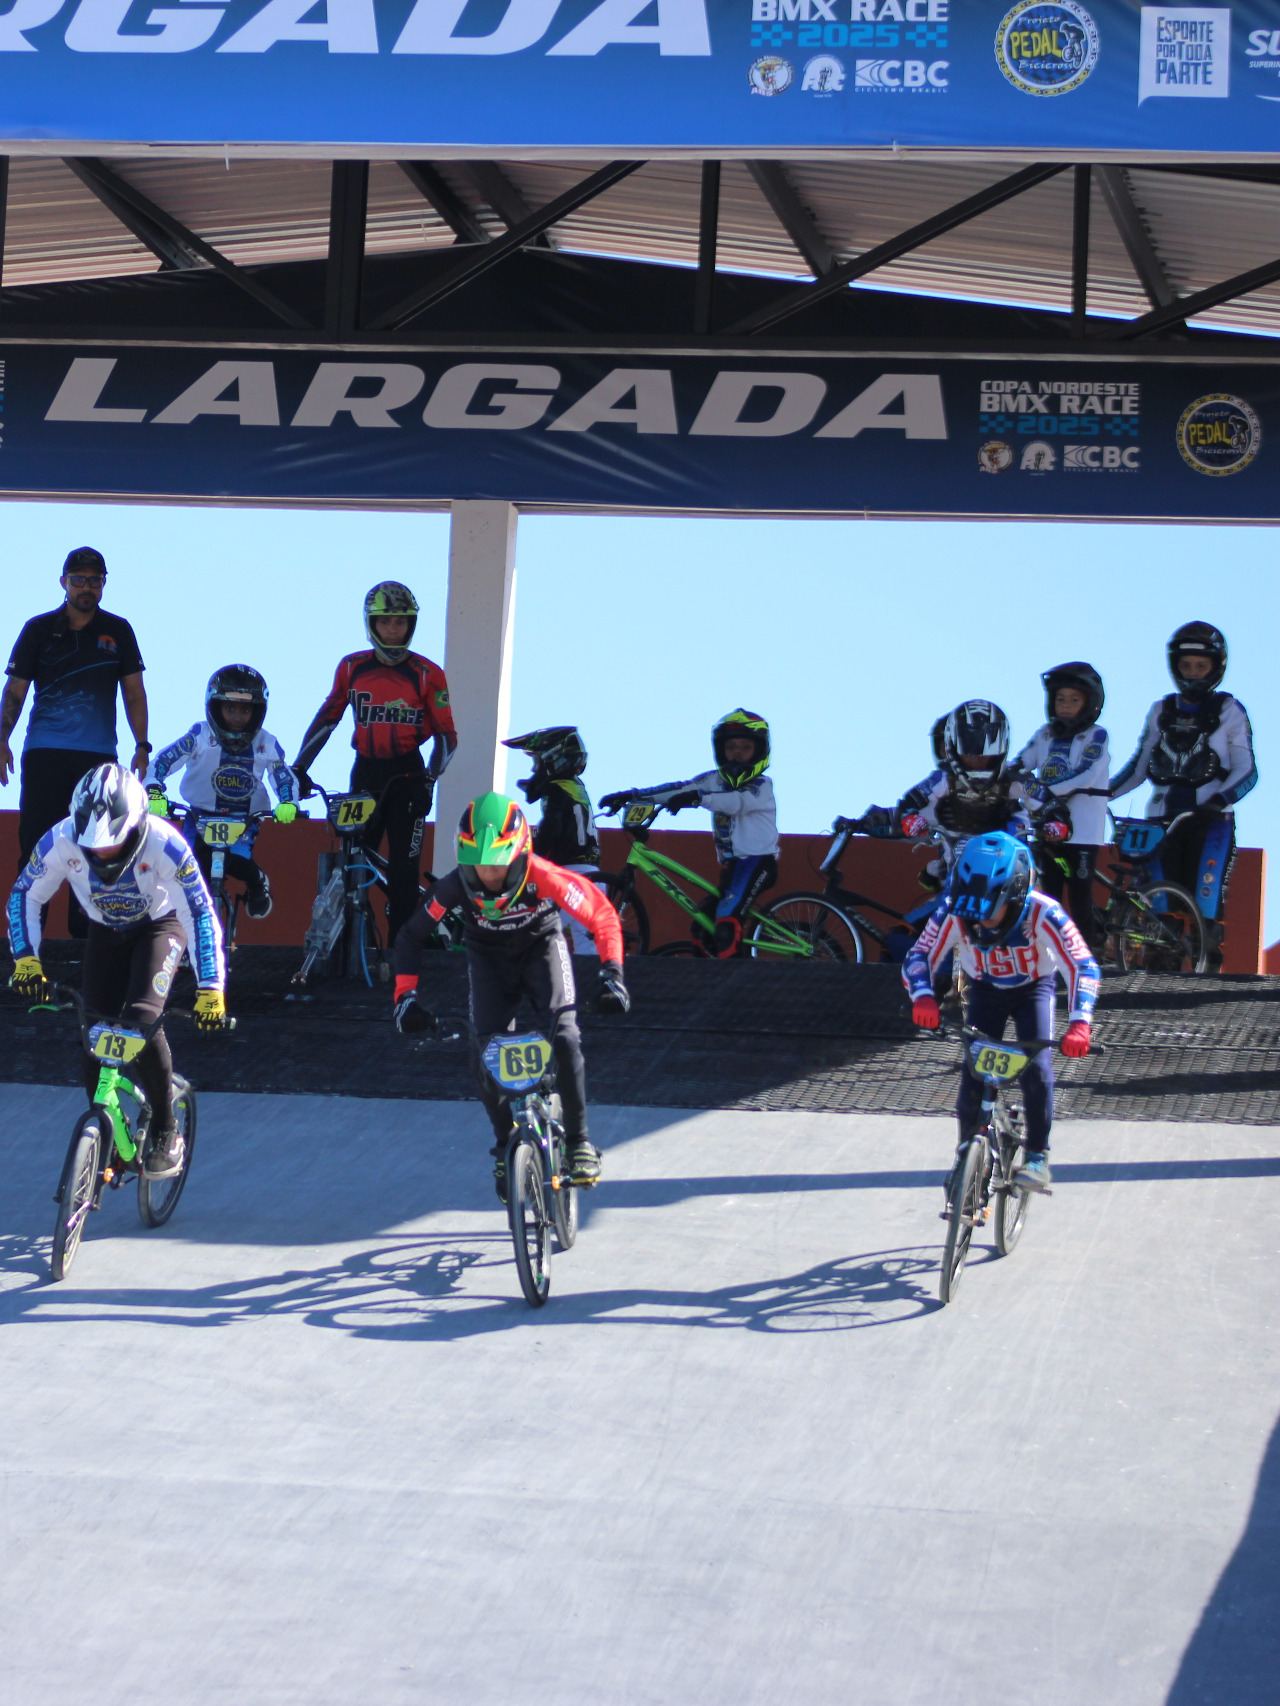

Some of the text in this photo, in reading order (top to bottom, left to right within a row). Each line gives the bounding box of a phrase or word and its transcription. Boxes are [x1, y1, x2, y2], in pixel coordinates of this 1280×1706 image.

[750, 0, 949, 22] BMX RACE
[797, 24, 900, 48] 2025
[1156, 16, 1214, 43] ESPORTE
[1010, 28, 1062, 60] PEDAL
[882, 60, 950, 87] CBC
[1155, 62, 1213, 85] PARTE
[43, 357, 948, 440] LARGADA
[980, 380, 1140, 396] COPA NORDESTE
[979, 394, 1140, 415] BMX RACE
[1016, 414, 1100, 436] 2025
[1188, 421, 1232, 446] PEDAL
[1084, 446, 1141, 468] CBC
[342, 801, 364, 822] 74
[211, 823, 229, 841] 18
[1130, 828, 1149, 849] 11
[104, 1035, 127, 1058] 13
[504, 1044, 543, 1077] 69
[982, 1050, 1010, 1075] 83
